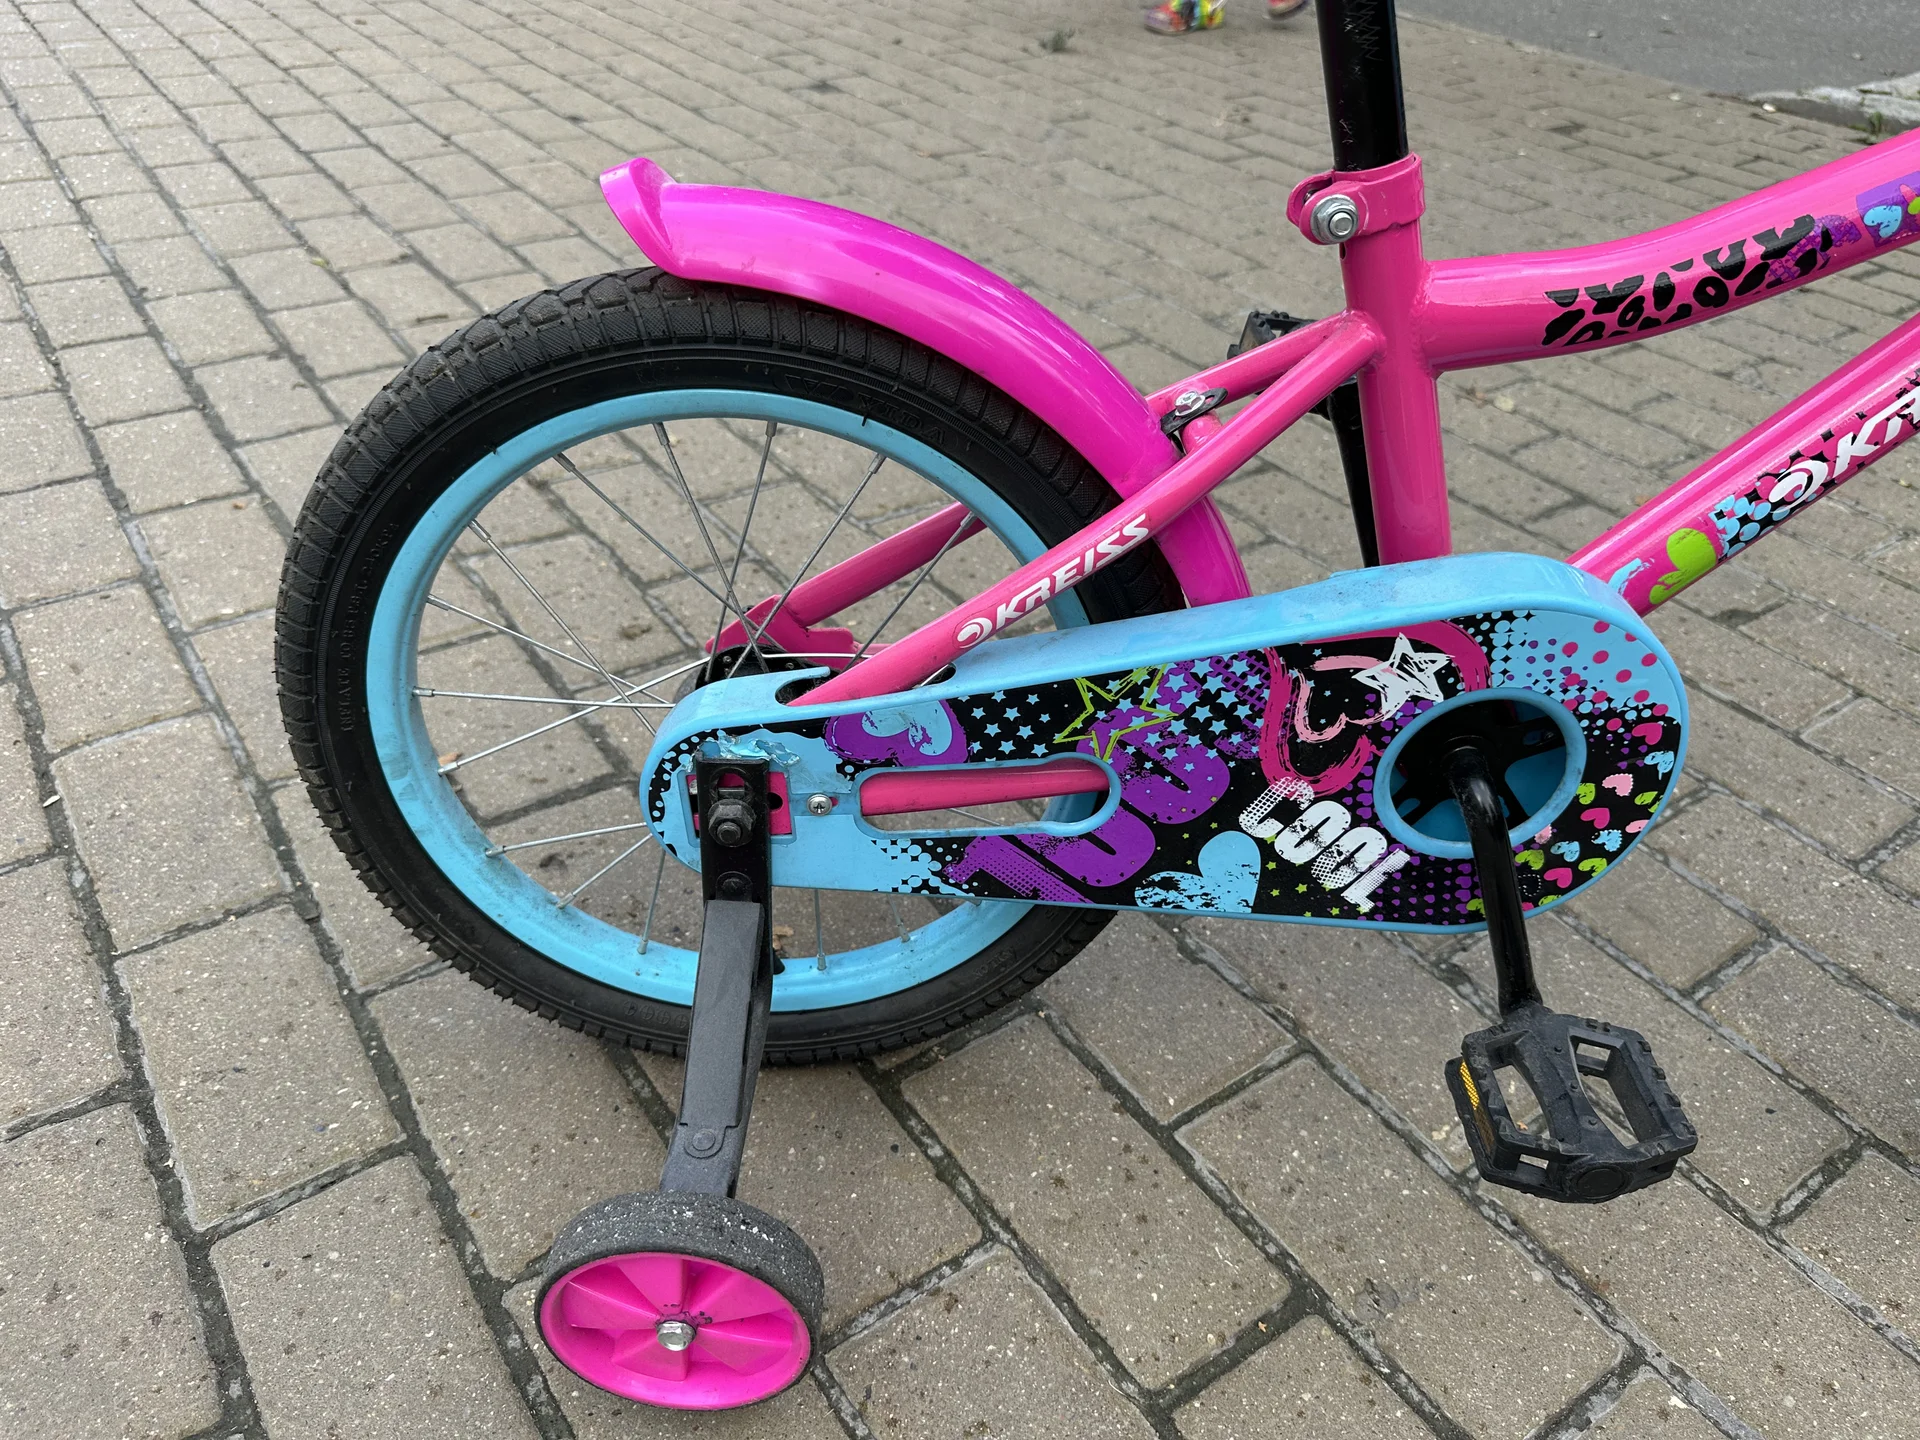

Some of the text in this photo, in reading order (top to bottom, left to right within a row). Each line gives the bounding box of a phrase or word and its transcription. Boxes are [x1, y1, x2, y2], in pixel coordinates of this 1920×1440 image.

[857, 391, 948, 446] VIDA
[996, 512, 1149, 631] KREISS
[339, 641, 352, 658] TO
[337, 667, 356, 732] INFLATE
[1238, 776, 1411, 912] COOL
